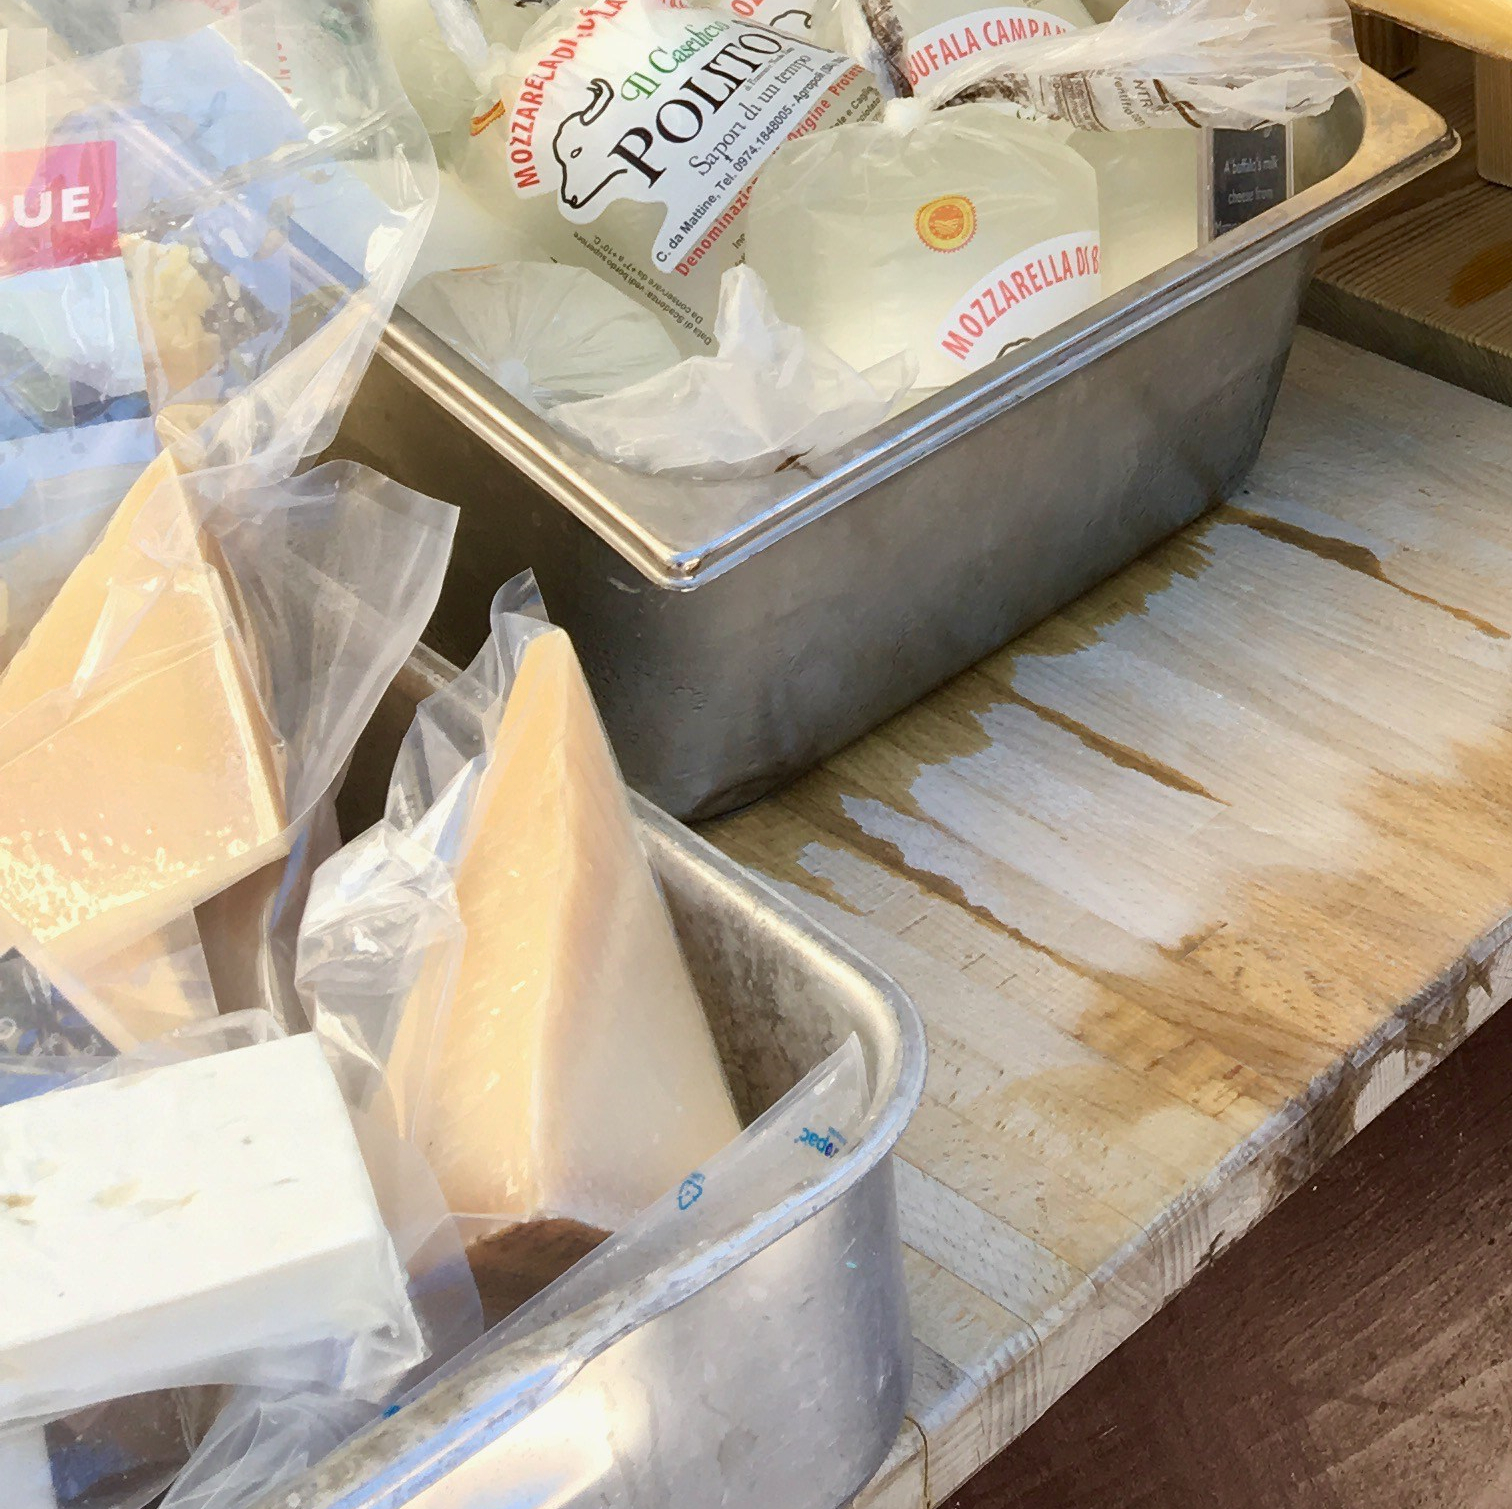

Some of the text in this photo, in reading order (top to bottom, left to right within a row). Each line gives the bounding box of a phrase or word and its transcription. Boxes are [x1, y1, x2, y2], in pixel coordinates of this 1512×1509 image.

[607, 33, 783, 189] POLITO
[668, 233, 685, 251] da
[679, 191, 722, 235] Mattine,
[715, 171, 738, 193] Tel.
[732, 103, 794, 173] 0974.1848005
[688, 119, 748, 177] Sapori
[738, 100, 763, 122] di
[757, 83, 781, 104] un
[777, 54, 815, 85] tempo
[940, 249, 1075, 361] MOZZARELLA
[1075, 245, 1090, 277] DI
